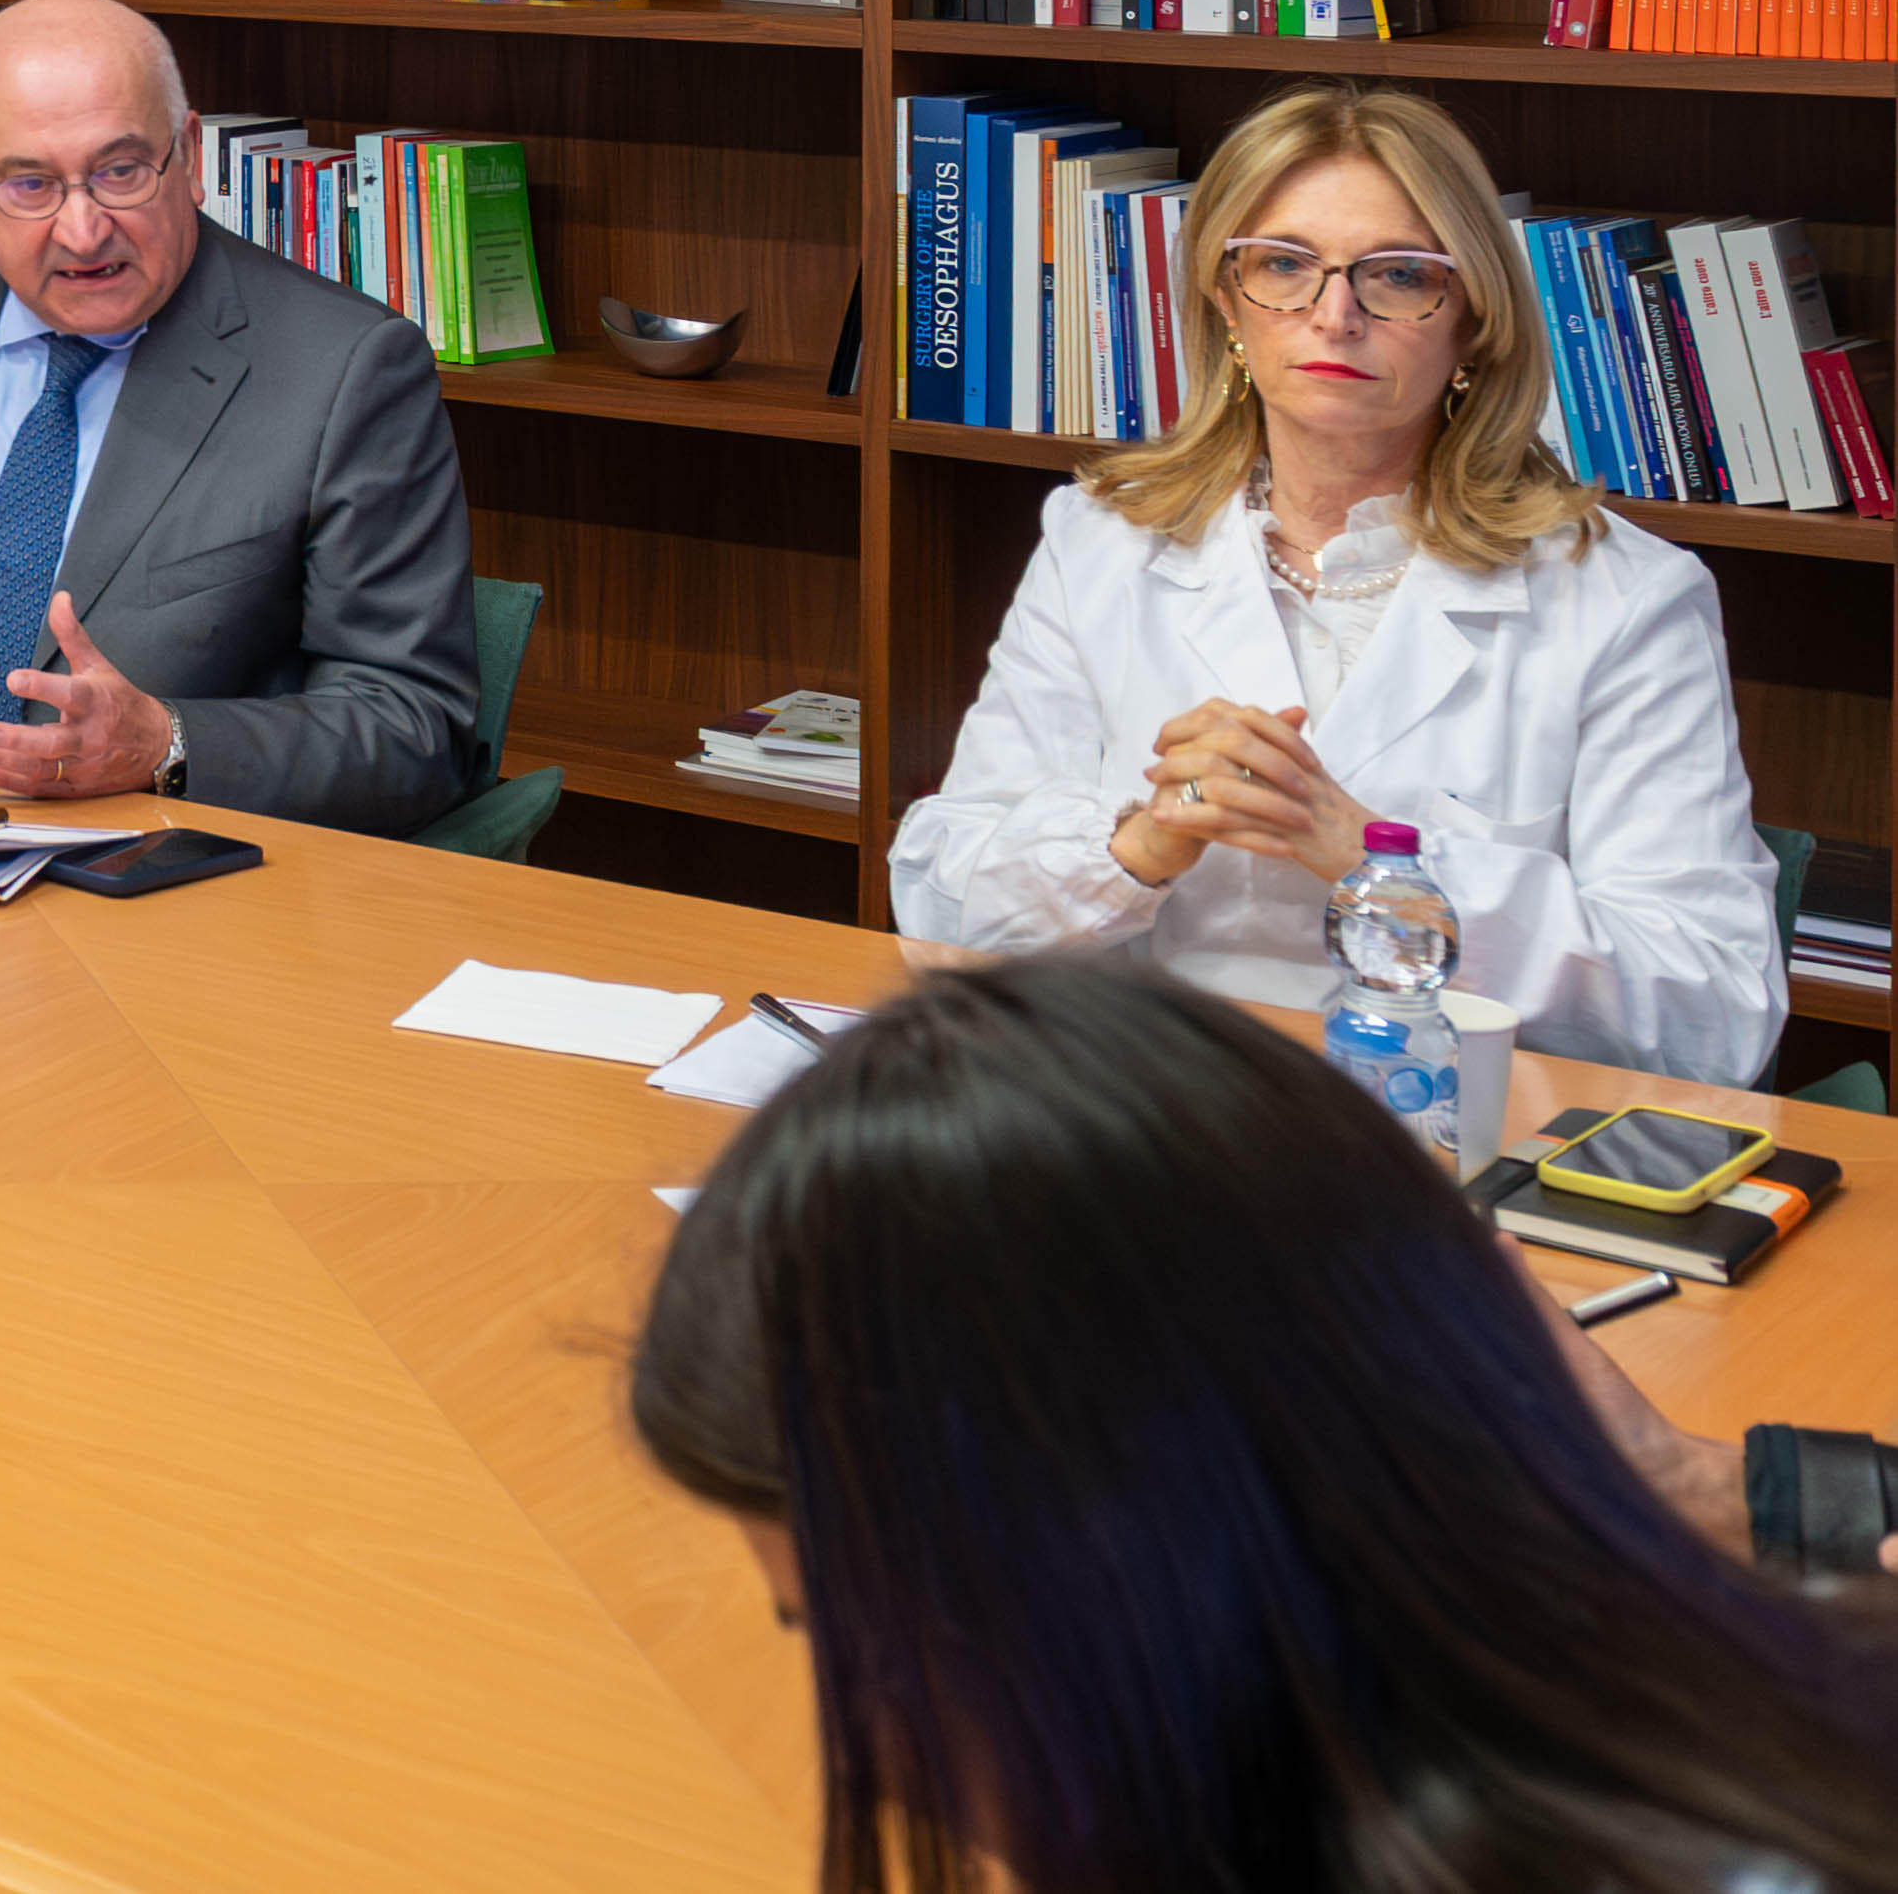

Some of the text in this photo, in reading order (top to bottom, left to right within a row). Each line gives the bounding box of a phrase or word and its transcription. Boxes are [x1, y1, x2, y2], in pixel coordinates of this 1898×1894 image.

[915, 189, 933, 368] SURGERY OF THE
[936, 162, 959, 369] OESOPHAGUS
[1693, 257, 1719, 316] L'altro cuore
[1747, 260, 1773, 320] L'altro cuore
[1646, 302, 1676, 380] ANNIVERSARIO
[1665, 382, 1684, 406] AIPA
[1670, 407, 1692, 449] PADOVA
[1682, 450, 1703, 488] ONLUS
